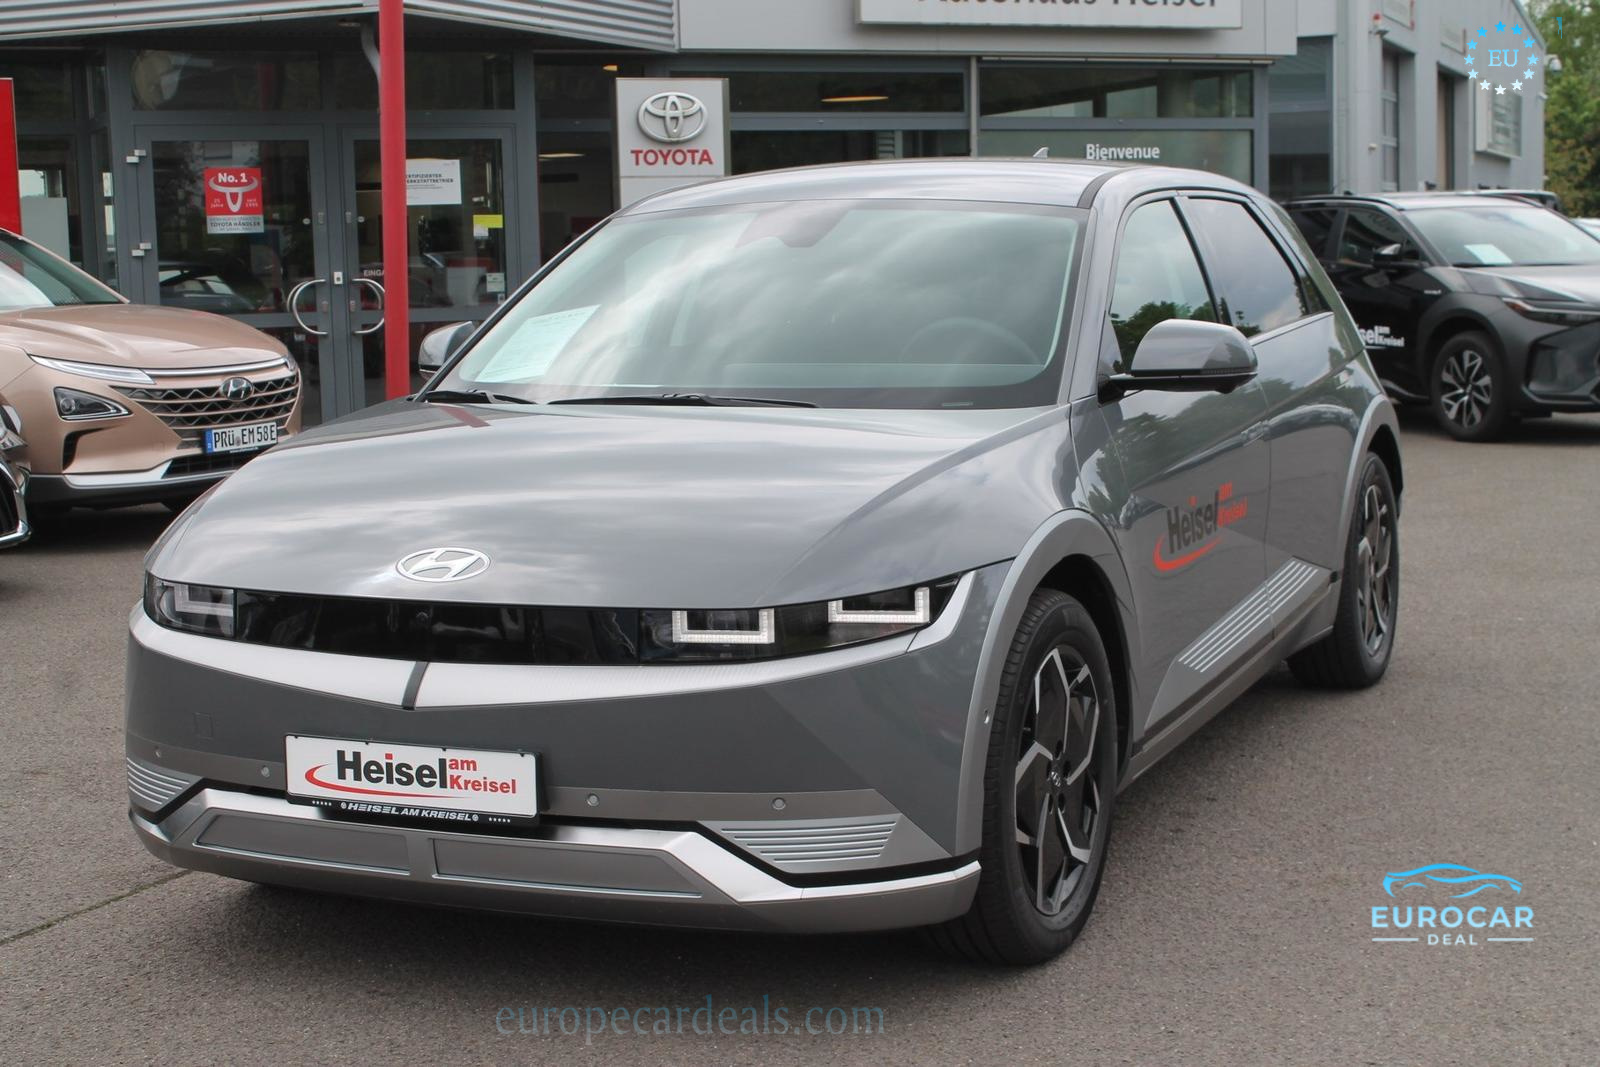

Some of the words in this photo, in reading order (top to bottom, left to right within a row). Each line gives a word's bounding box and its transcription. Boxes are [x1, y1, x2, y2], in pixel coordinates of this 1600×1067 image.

[630, 149, 713, 166] TOYOTA
[1085, 143, 1160, 160] Bienvenue
[217, 172, 238, 183] No.
[240, 172, 248, 183] 1
[1167, 490, 1219, 554] Heisel
[337, 749, 447, 789] Heisel
[448, 758, 478, 772] am
[449, 774, 517, 794] Kreisel
[348, 802, 399, 815] HEISEL
[400, 808, 419, 817] AM
[421, 810, 471, 821] KREISEL
